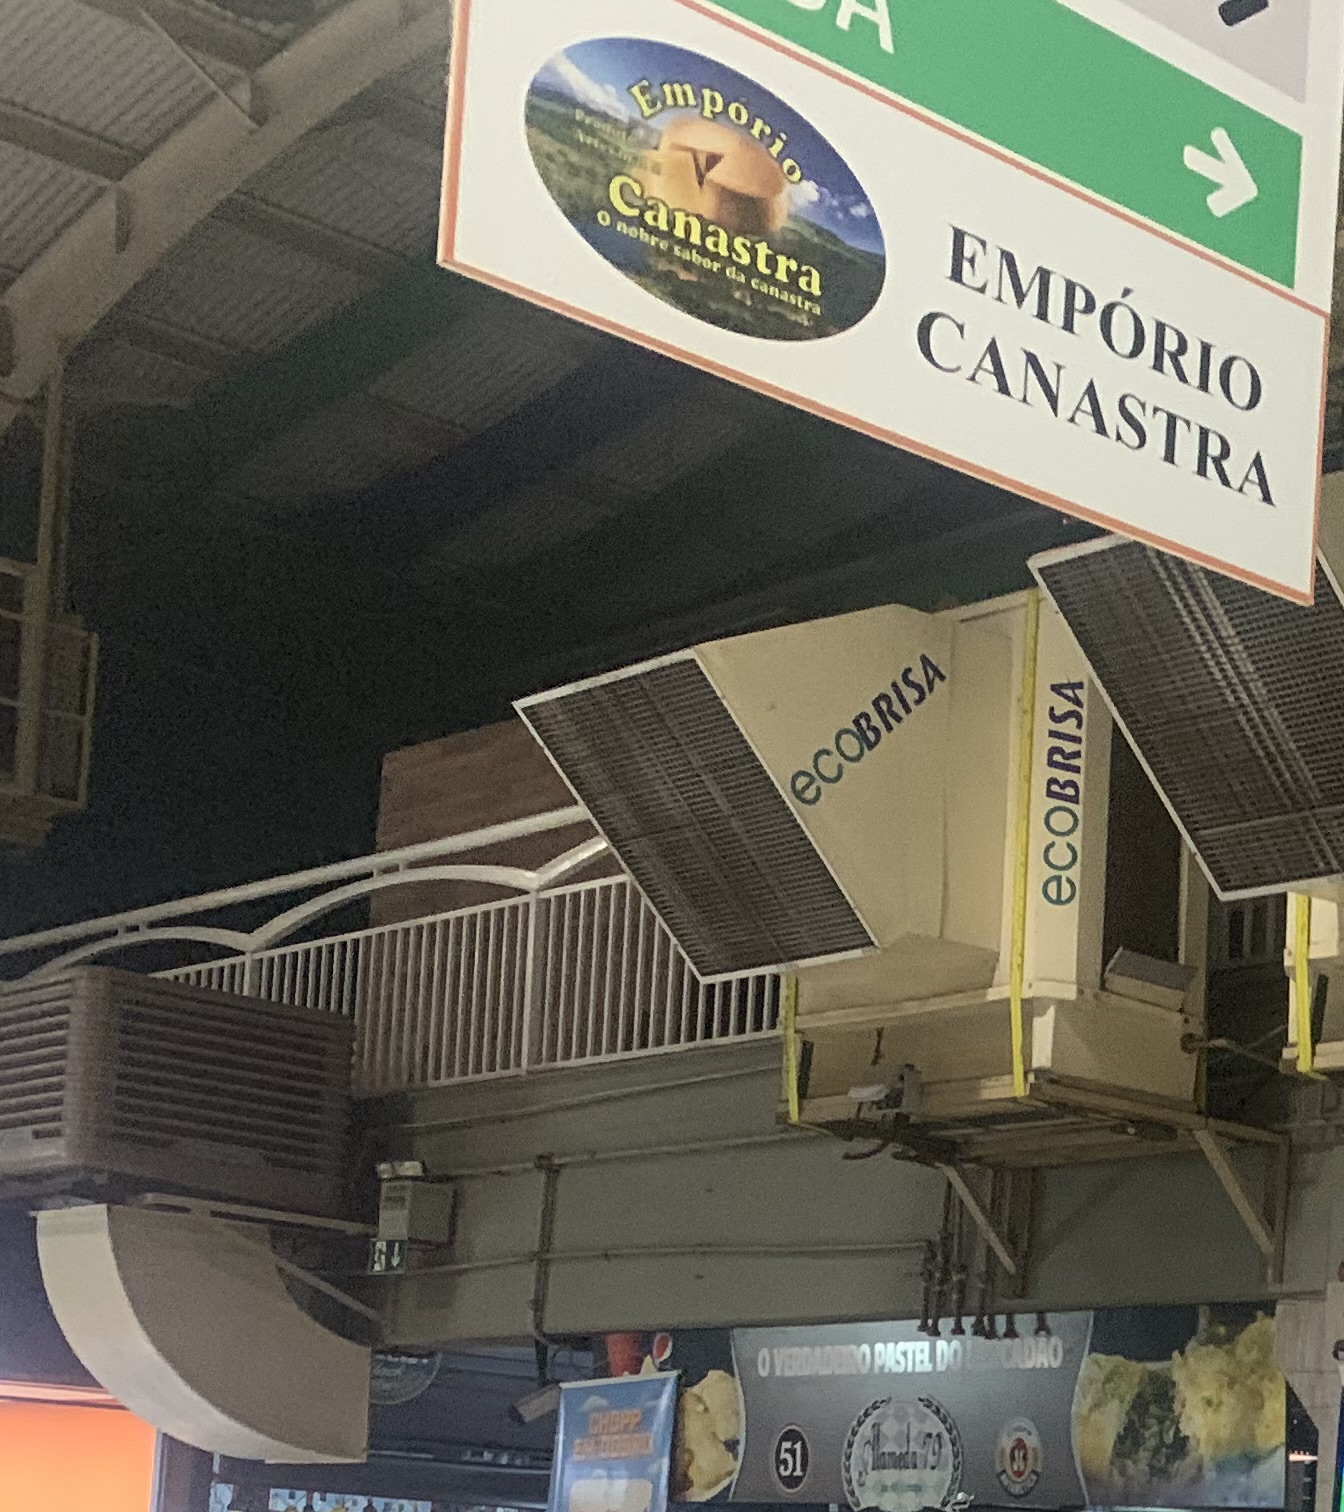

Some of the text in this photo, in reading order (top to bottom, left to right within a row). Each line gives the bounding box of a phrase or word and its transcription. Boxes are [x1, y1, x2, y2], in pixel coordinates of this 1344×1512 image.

[609, 175, 822, 296] Canastra
[674, 245, 721, 273] sabor
[726, 265, 746, 283] da
[751, 277, 822, 316] canastra
[947, 224, 1263, 412] EMPÓRIO
[917, 311, 1275, 508] CANASTRA
[791, 652, 946, 806] ecoBRISA
[1041, 677, 1085, 908] ecoBRISA
[875, 1341, 932, 1373] PASTEL
[936, 1340, 962, 1371] DO
[780, 1441, 803, 1477] 51
